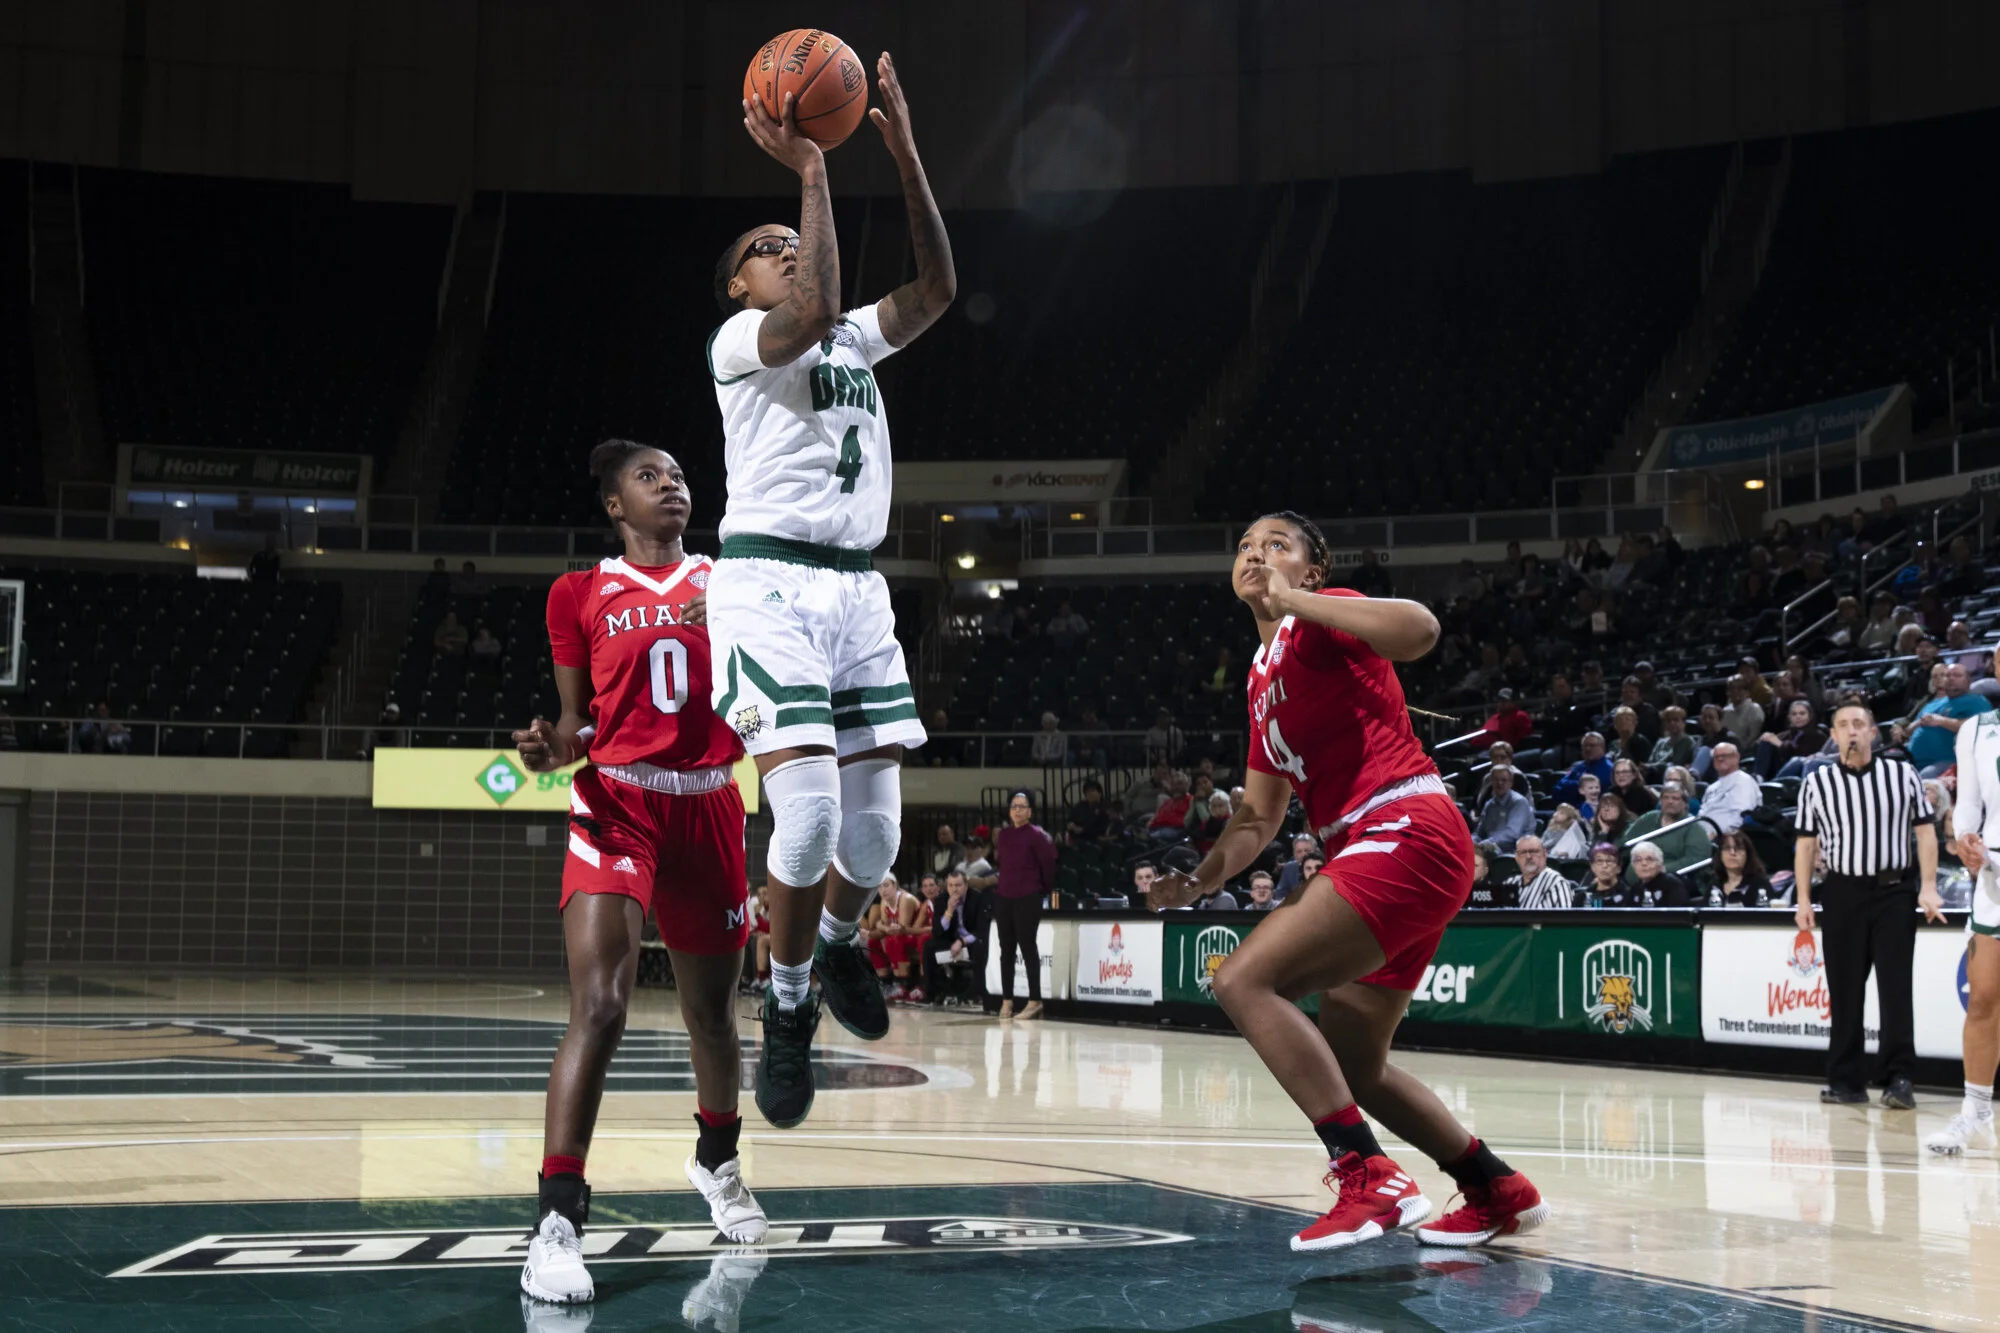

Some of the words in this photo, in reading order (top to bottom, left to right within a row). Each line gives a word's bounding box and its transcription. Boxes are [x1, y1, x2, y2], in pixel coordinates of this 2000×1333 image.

[163, 457, 240, 477] Holzer
[836, 425, 863, 494] 4
[282, 463, 358, 483] Holzer
[648, 638, 689, 715] 0
[486, 764, 516, 793] G
[612, 864, 638, 875] adidas
[725, 902, 746, 931] M
[1719, 1017, 1745, 1033] Three
[1747, 1019, 1801, 1037] Convenient
[1804, 1021, 1831, 1038] Athen
